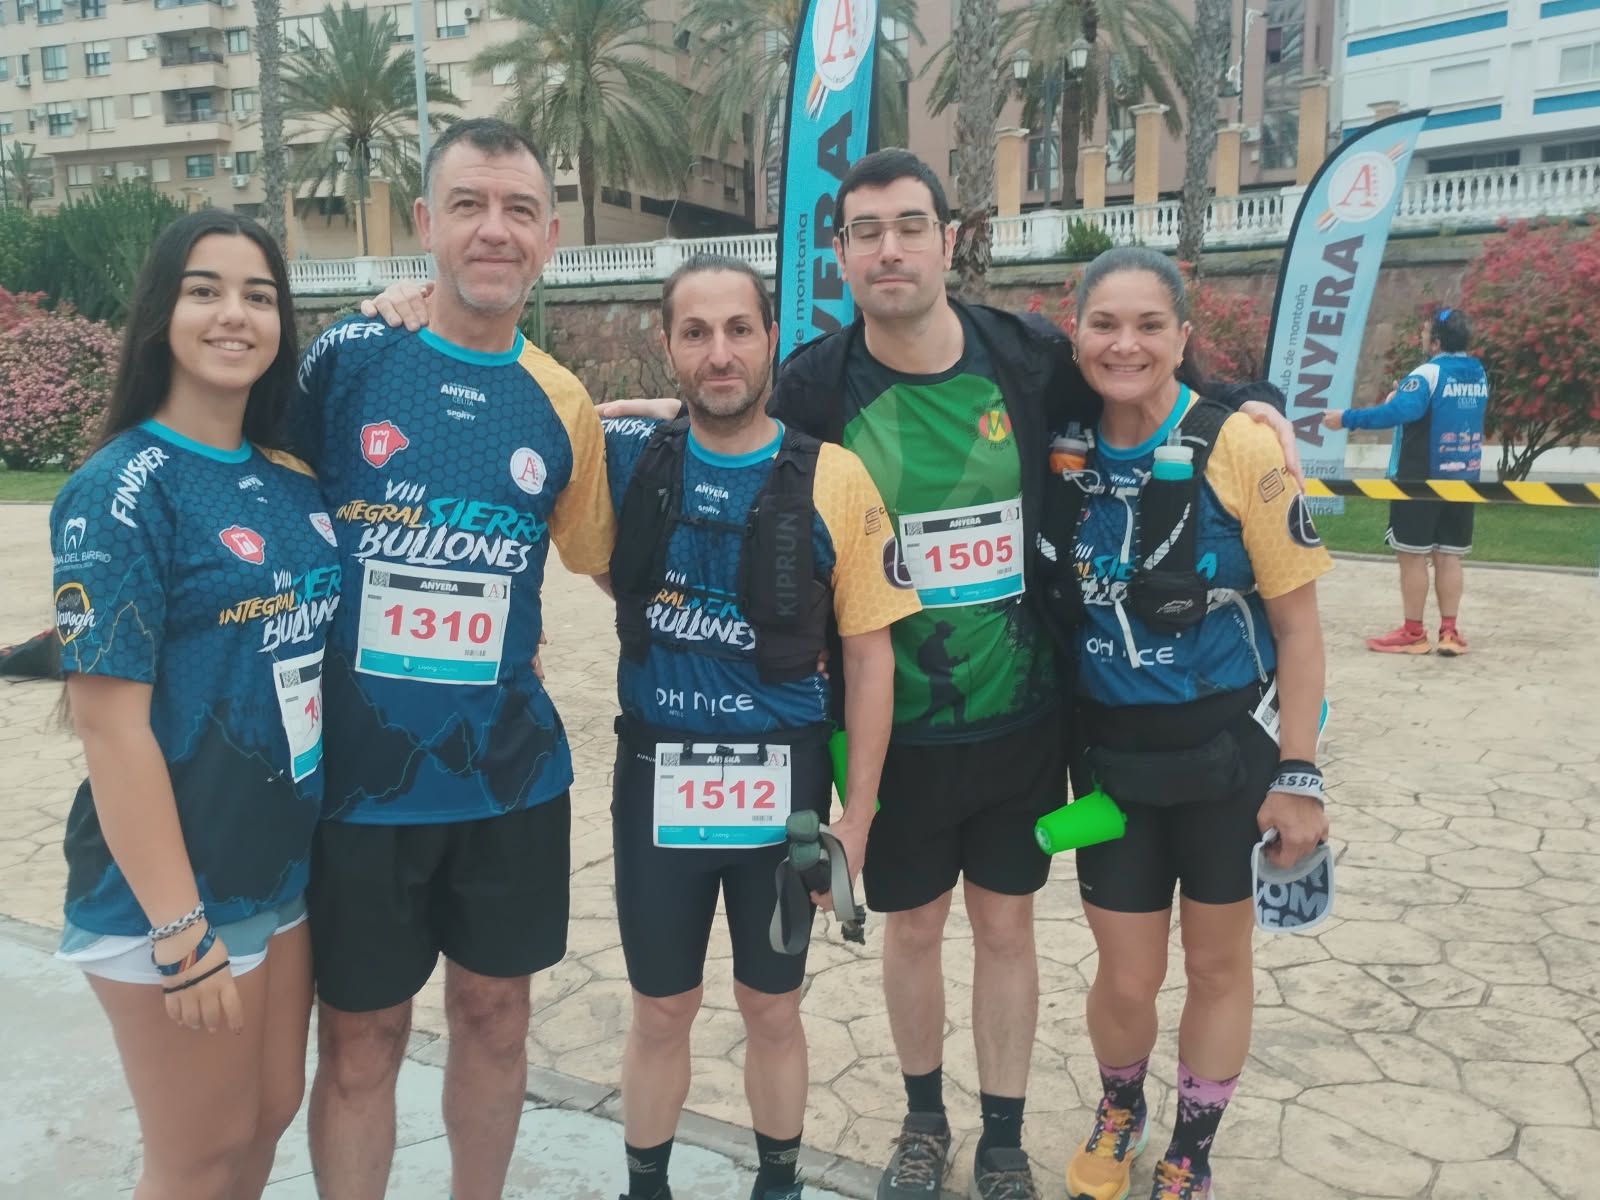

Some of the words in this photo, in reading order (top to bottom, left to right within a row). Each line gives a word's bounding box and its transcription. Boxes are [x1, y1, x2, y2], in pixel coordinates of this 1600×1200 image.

[795, 213, 808, 321] montaña
[1289, 284, 1309, 346] montaña
[1293, 234, 1365, 448] ANYERA
[298, 322, 386, 395] FINISHER
[1285, 350, 1297, 367] de
[440, 384, 486, 403] ANYERA
[1442, 383, 1488, 398] ANYERA
[111, 447, 170, 529] FINISHER
[386, 478, 426, 503] VIII
[694, 483, 729, 500] ANYERA
[336, 499, 429, 528] INTEGRAL
[950, 516, 981, 529] ANYERA
[352, 520, 534, 573] BULLONES
[924, 535, 1014, 573] 1505
[776, 512, 799, 616] KIPRUN
[273, 567, 292, 593] VIII
[419, 579, 459, 593] ANYERA
[218, 589, 300, 626] INTEGRAL
[384, 604, 492, 644] 1310
[1086, 637, 1114, 656] OH
[678, 780, 776, 810] 1512
